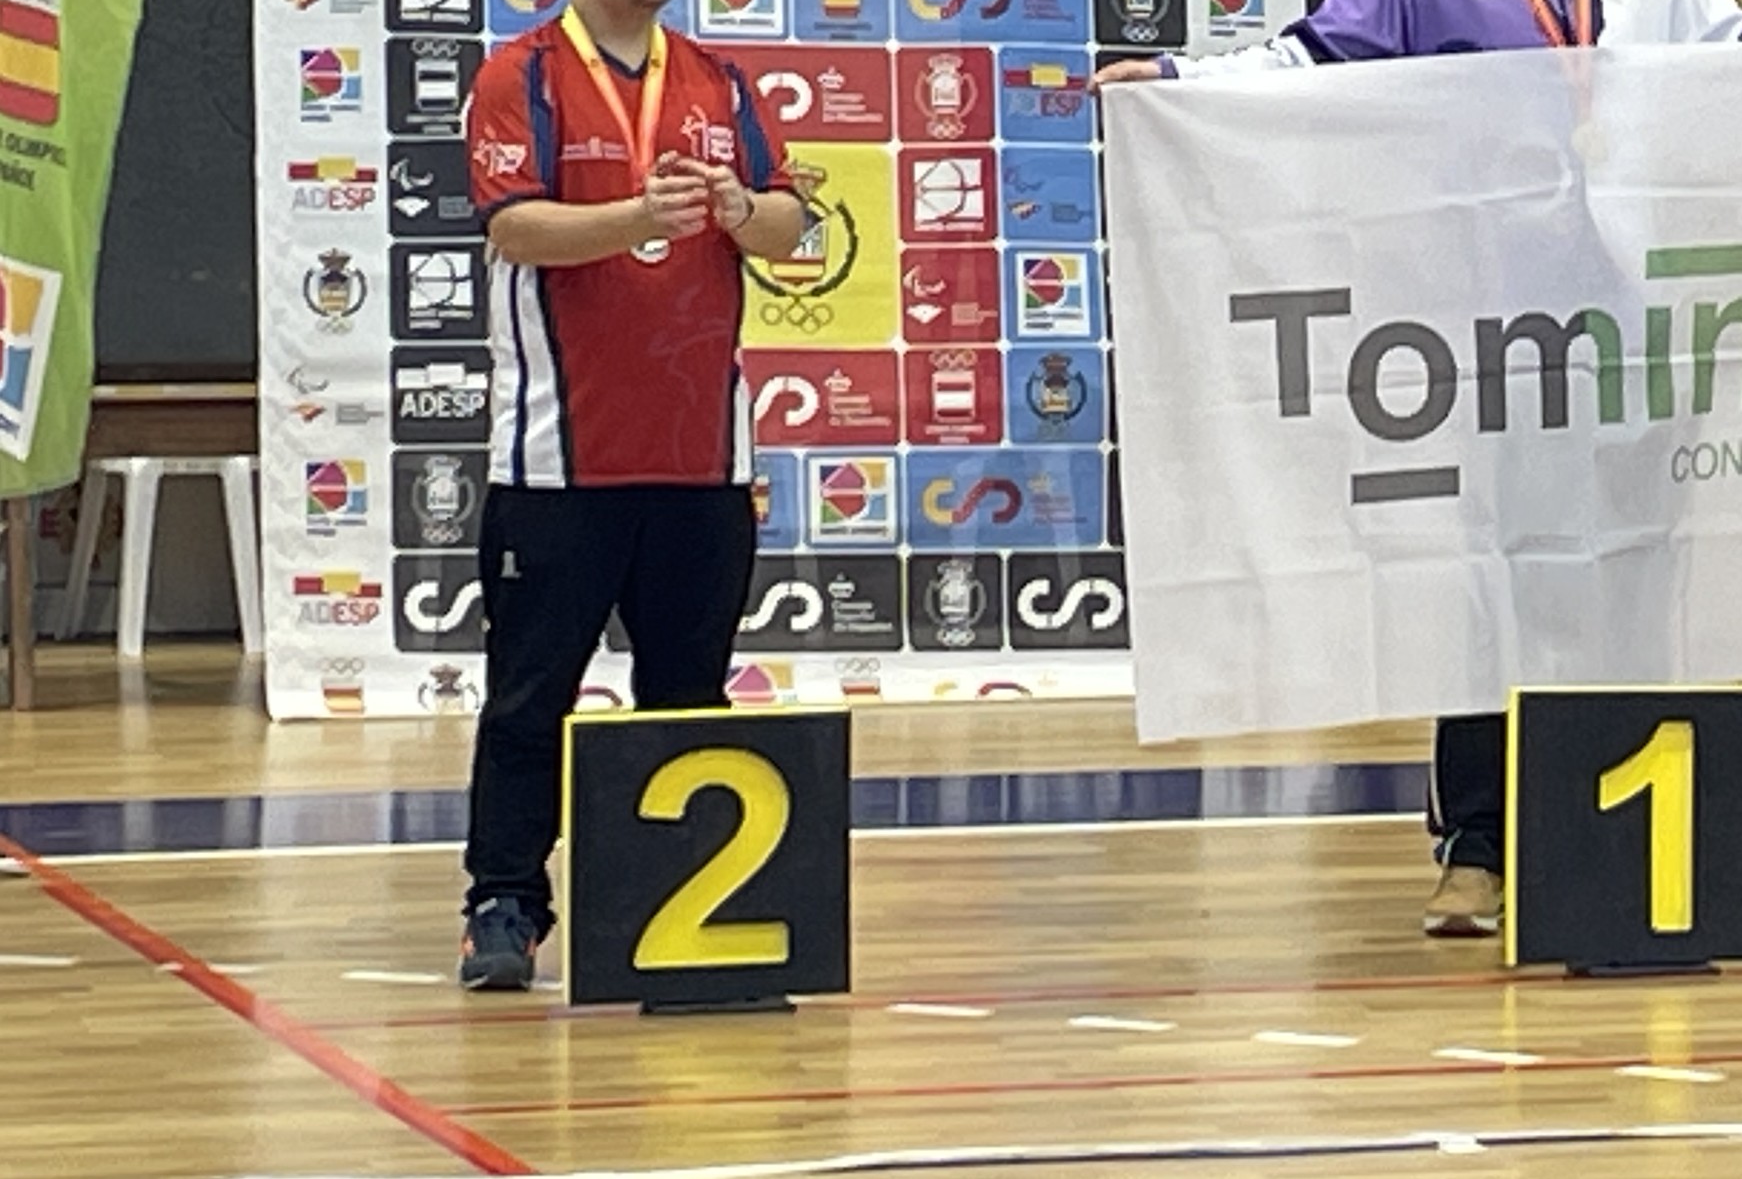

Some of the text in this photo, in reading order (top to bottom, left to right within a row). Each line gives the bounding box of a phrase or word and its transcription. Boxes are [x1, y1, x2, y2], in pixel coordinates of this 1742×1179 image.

[291, 187, 376, 212] ADESP
[400, 391, 486, 419] ADESP
[297, 600, 381, 626] ADESP
[1600, 720, 1694, 934] 1
[633, 746, 791, 972] 2
